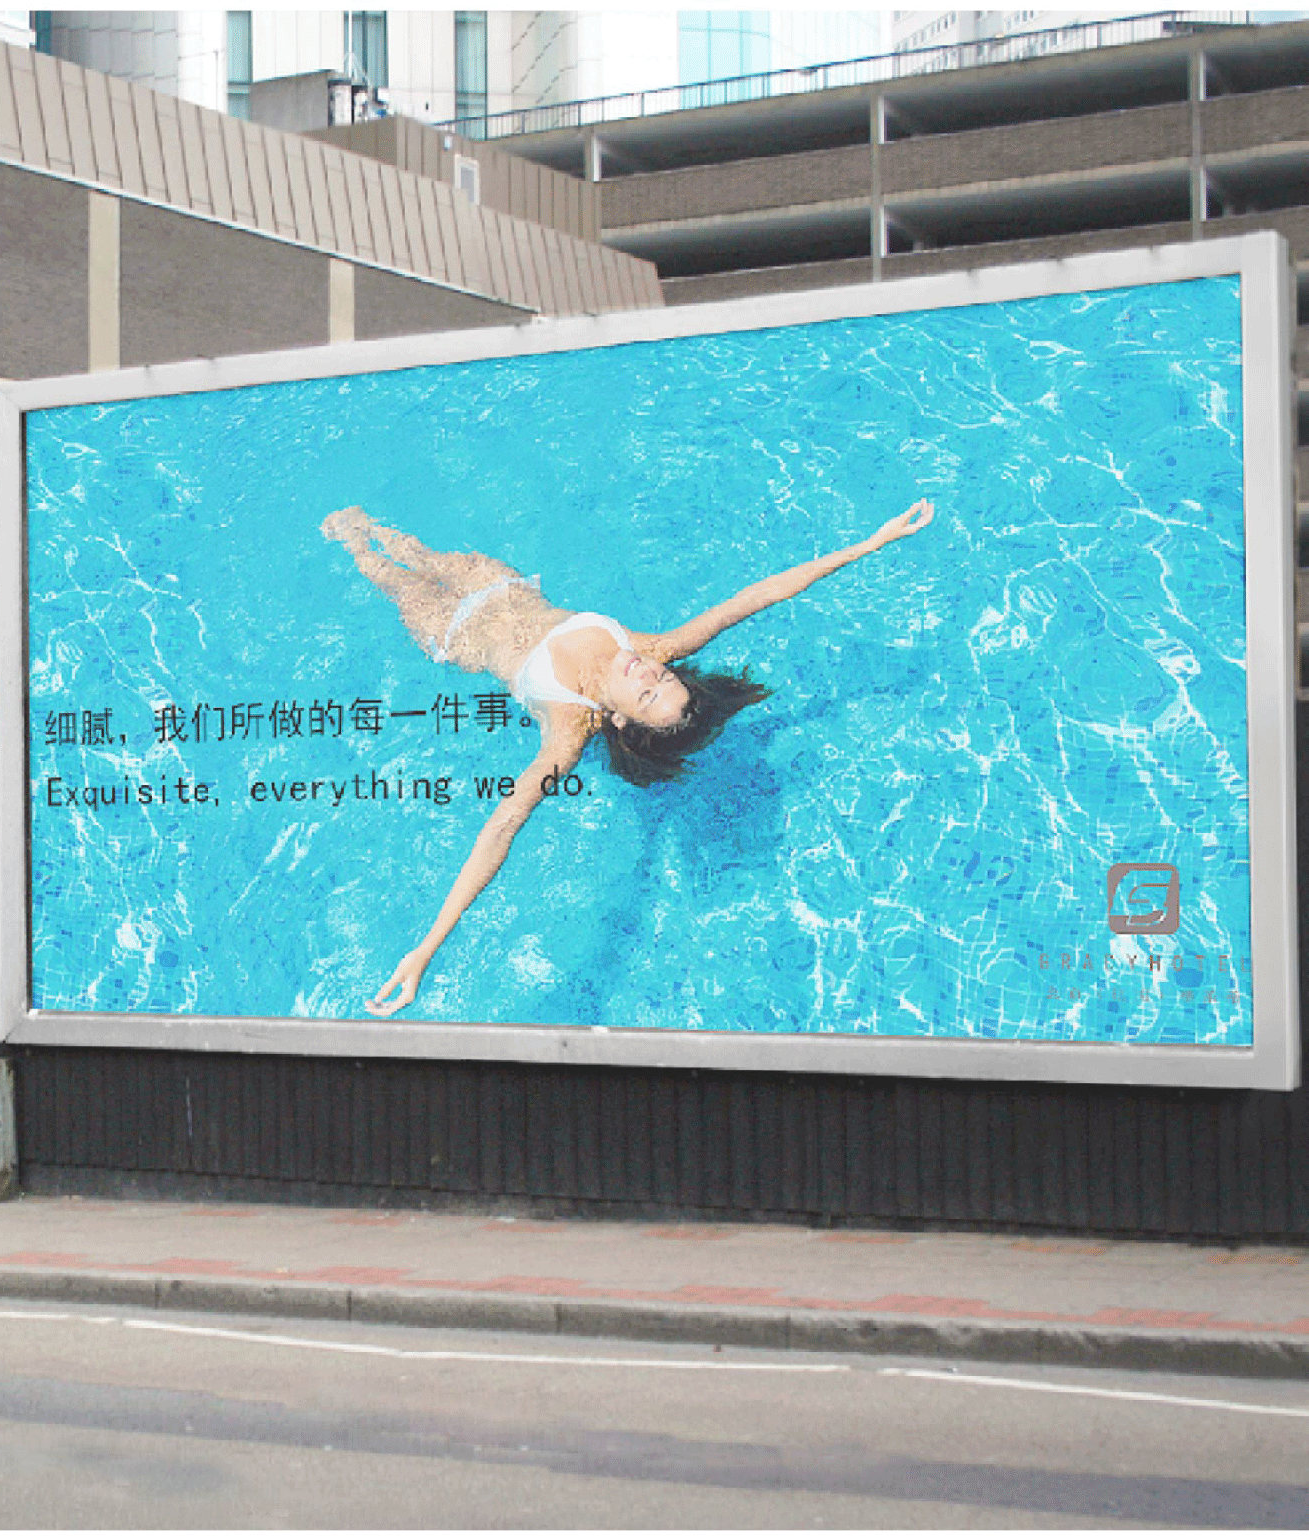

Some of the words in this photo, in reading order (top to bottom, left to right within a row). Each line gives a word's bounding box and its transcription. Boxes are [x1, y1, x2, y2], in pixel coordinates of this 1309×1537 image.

[47, 774, 220, 812] Exquisite,
[250, 768, 453, 806] everything
[473, 775, 515, 798] we
[540, 764, 593, 797] do.
